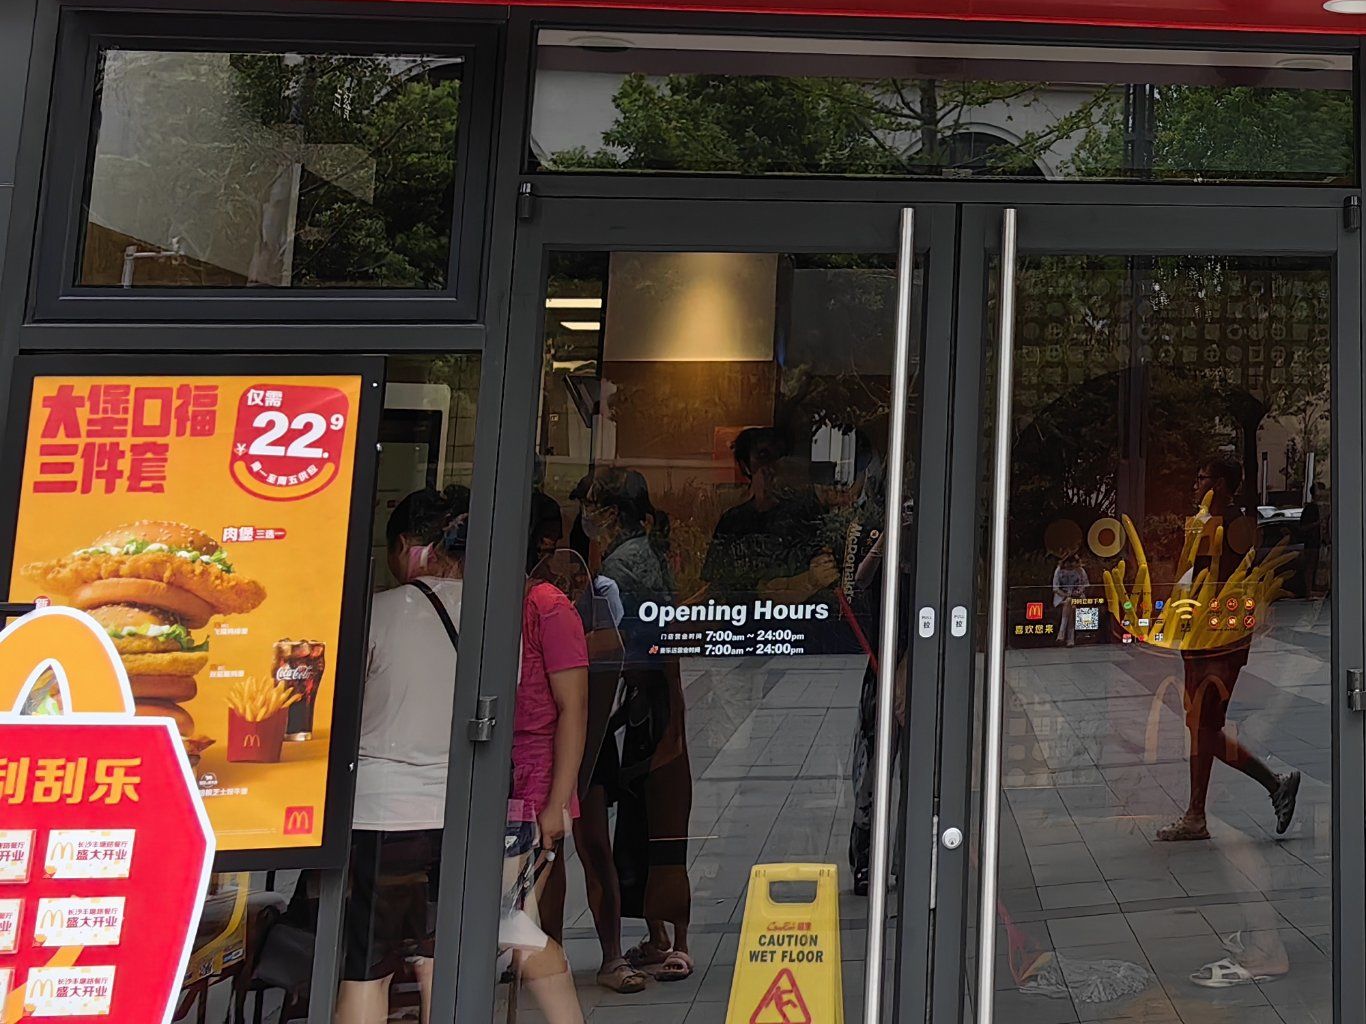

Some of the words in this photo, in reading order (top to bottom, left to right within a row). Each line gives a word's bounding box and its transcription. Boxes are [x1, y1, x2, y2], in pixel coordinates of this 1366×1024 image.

[247, 389, 283, 407] 仅需
[40, 383, 219, 440] 大堡口福
[33, 442, 169, 495] 三件套
[638, 599, 747, 627] Opening
[754, 600, 829, 620] Hours
[705, 630, 745, 642] 7:00am
[756, 629, 805, 642] 24:00pm
[1015, 624, 1055, 635] 喜欢您来
[704, 644, 744, 655] 7:00am
[755, 643, 804, 656] 24:00pm
[76, 849, 127, 861] 盛大开业
[66, 916, 118, 928] 盛大开业
[758, 934, 818, 946] CAUTION
[749, 950, 777, 963] WET
[781, 950, 824, 963] FLOOR
[56, 985, 107, 997] 盛大开业
